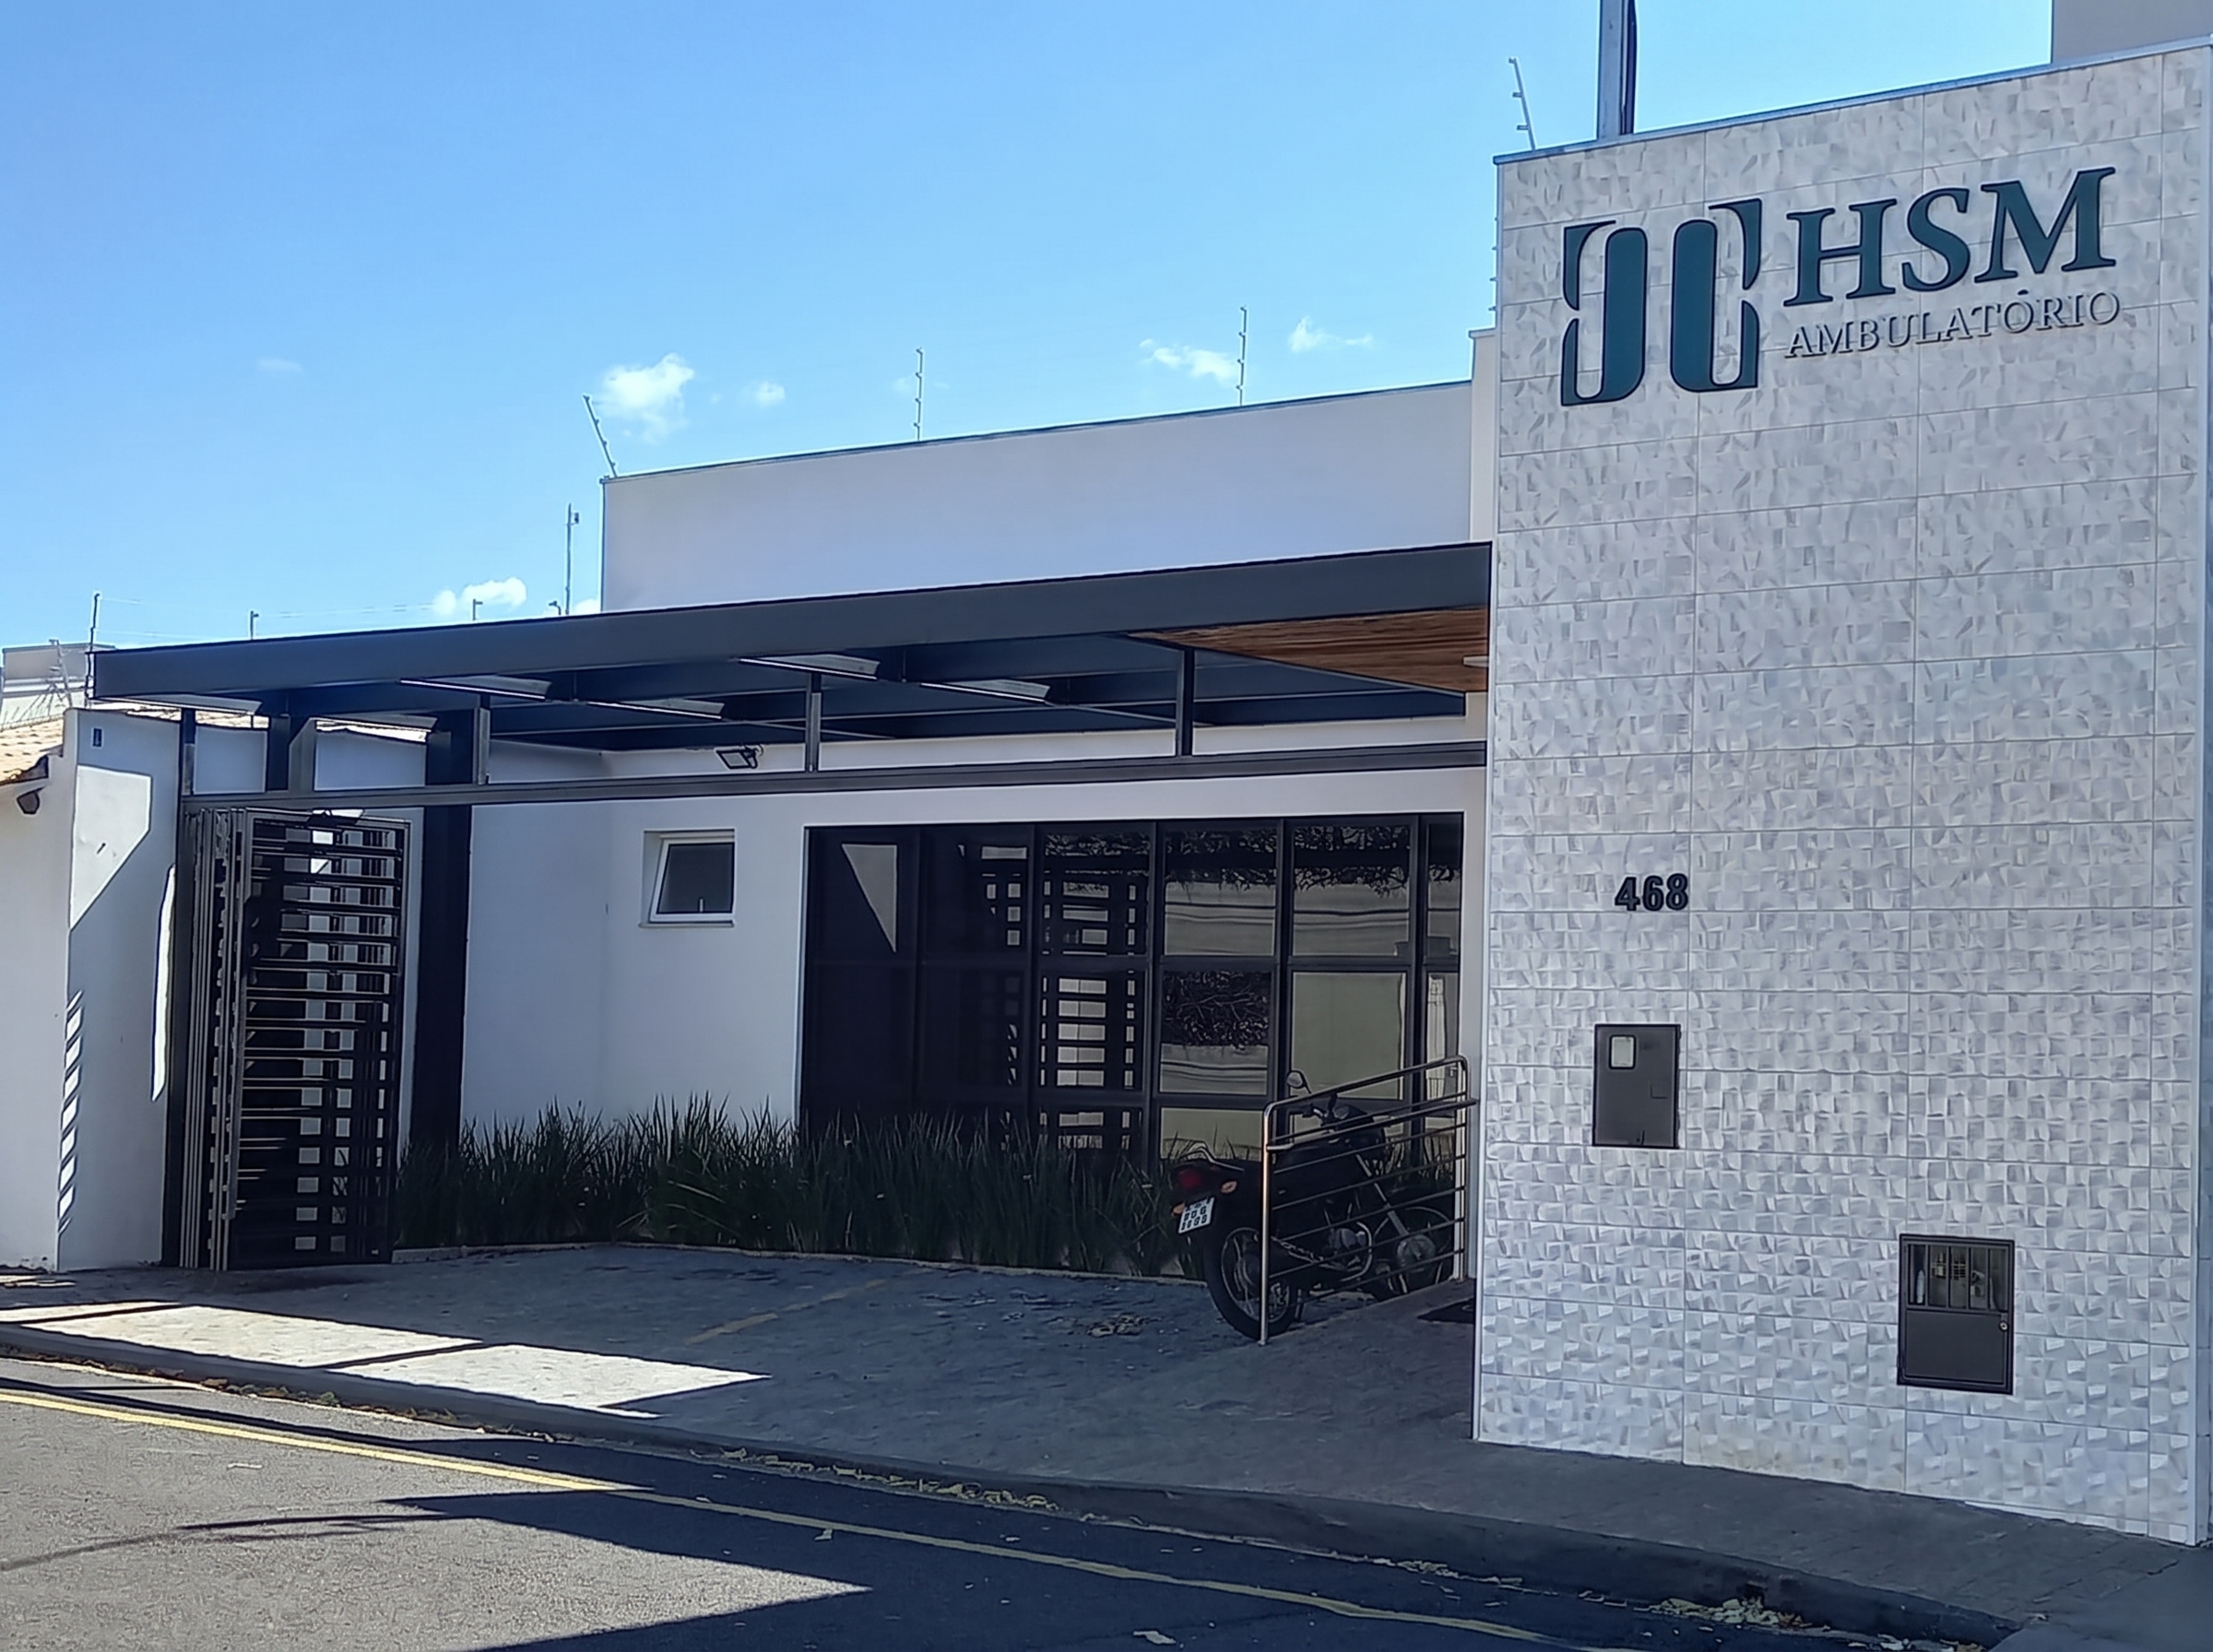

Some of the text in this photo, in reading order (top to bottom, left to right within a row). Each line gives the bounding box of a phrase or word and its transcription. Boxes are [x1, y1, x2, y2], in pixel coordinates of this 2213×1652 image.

[1783, 167, 2116, 307] HSM
[1783, 289, 2120, 359] AMBULATÓRIO
[1615, 873, 1688, 911] 468
